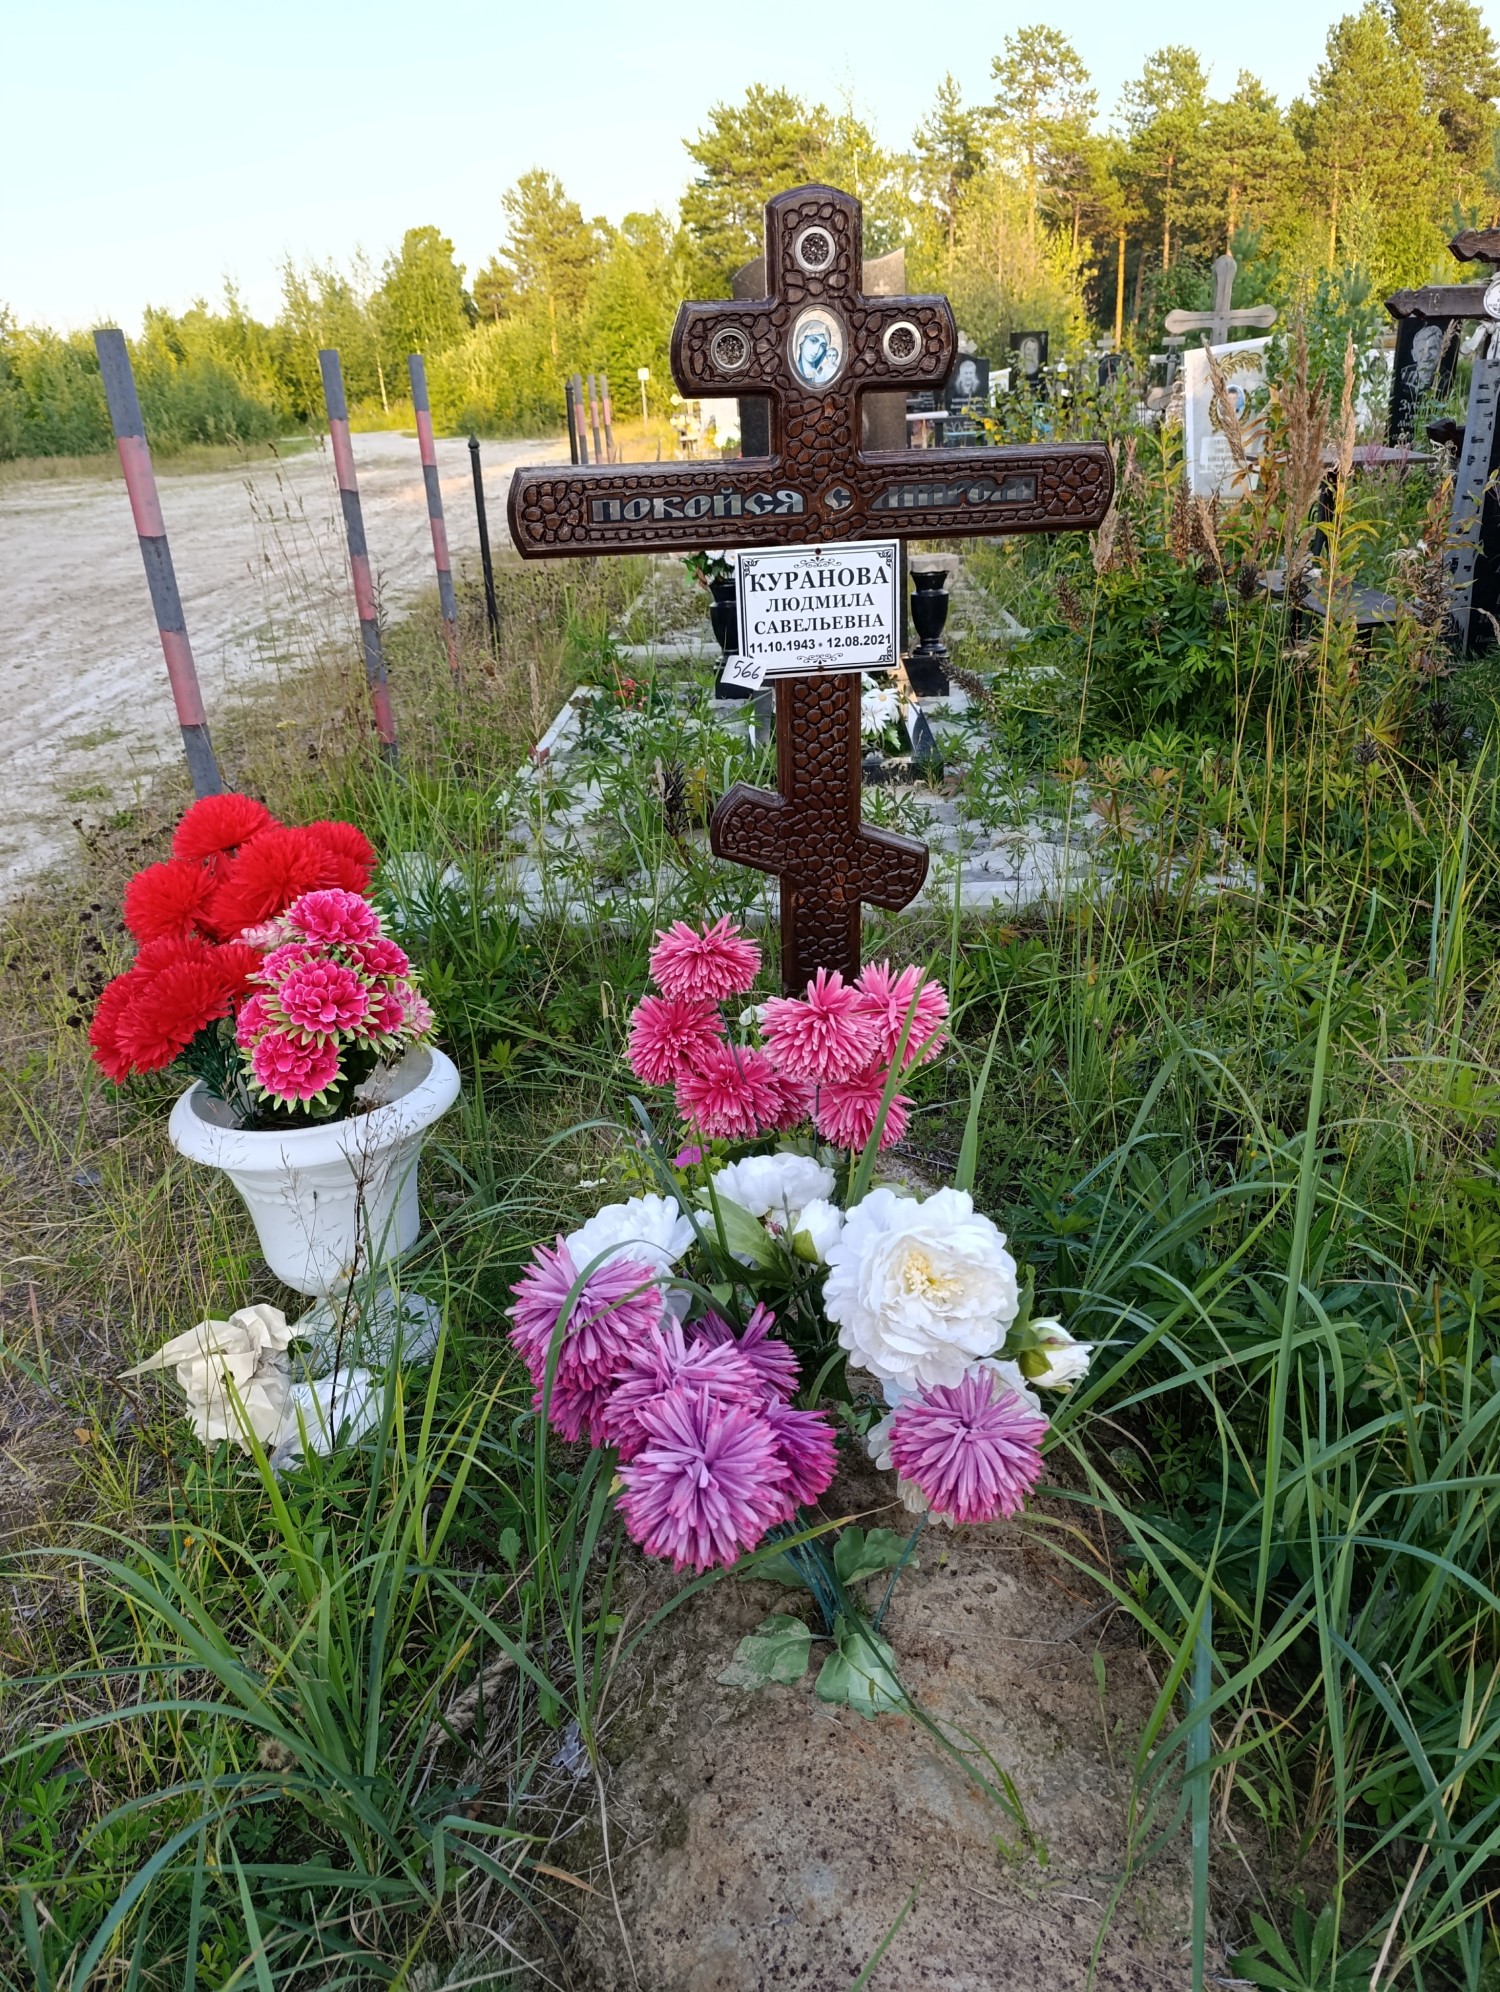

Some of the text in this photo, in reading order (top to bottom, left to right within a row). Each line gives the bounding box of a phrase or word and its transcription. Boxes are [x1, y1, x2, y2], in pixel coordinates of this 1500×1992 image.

[749, 565, 889, 593] КУРАНОВА
[765, 592, 875, 613] ЛЮДМИЛА
[754, 613, 885, 635] САВЕЛЬЕВНА
[749, 633, 891, 654] 11.10.1943 12.08.2021
[732, 660, 760, 680] 566
